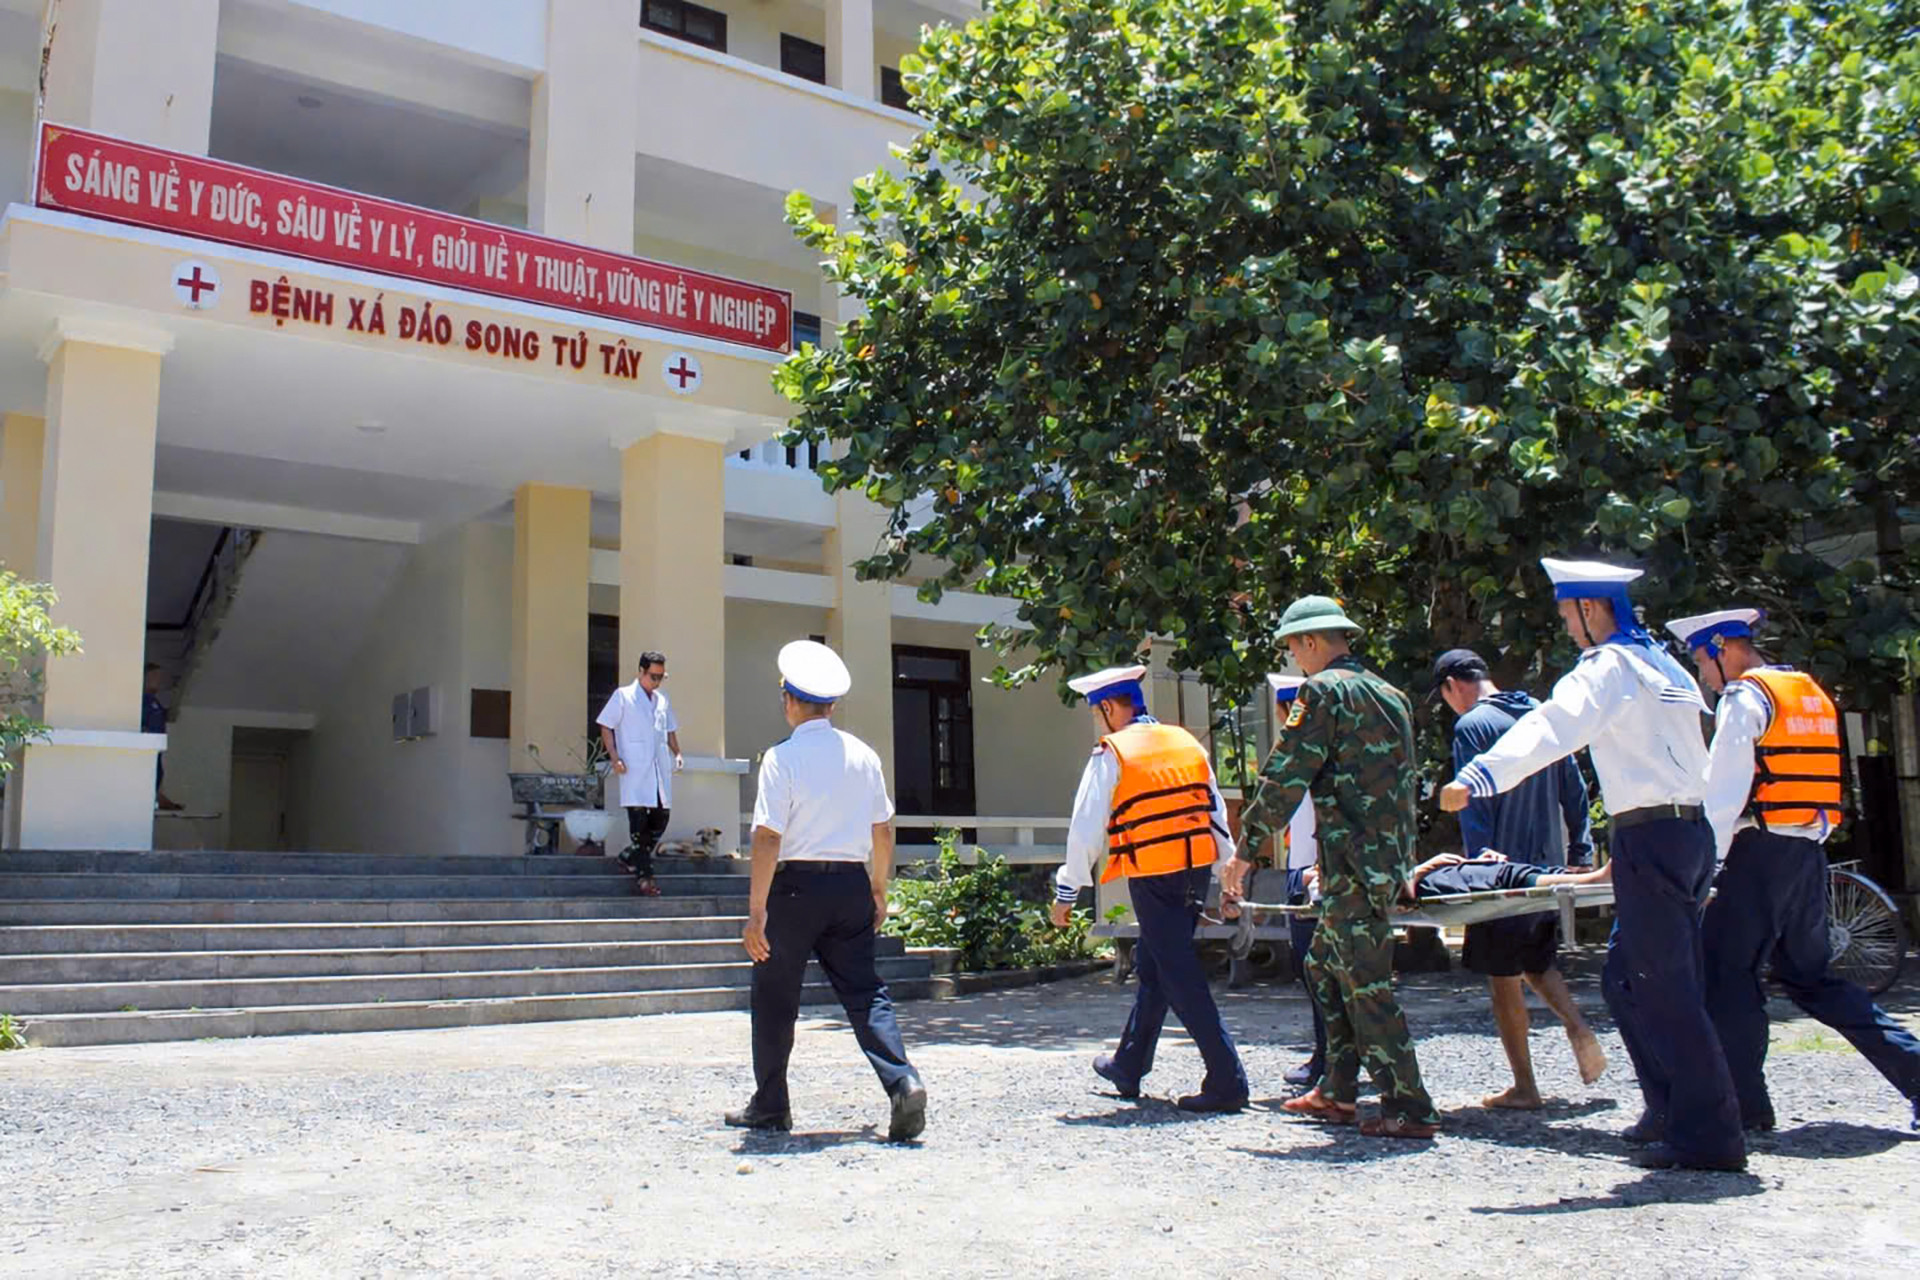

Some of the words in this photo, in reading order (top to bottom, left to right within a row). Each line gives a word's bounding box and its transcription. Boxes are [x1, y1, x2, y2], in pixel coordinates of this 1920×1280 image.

[65, 149, 140, 204] SÁNG
[149, 160, 181, 212] VỀ
[189, 179, 205, 216] Y
[276, 196, 326, 242] SÂU
[333, 201, 363, 250] VỀ
[370, 218, 384, 254] Y
[432, 227, 477, 274] GIỎI
[483, 234, 509, 280] VỀ
[515, 250, 528, 284] Y
[607, 266, 661, 314] VỮNG
[664, 274, 687, 319] VỀ
[693, 289, 705, 321] Y
[709, 292, 777, 340] NGHIỆP
[249, 275, 334, 327] BỆNH
[347, 292, 386, 335] XÁ
[398, 301, 452, 345] ĐẢO
[465, 320, 541, 361] SONG
[552, 330, 588, 369] TỬ
[599, 338, 642, 380] TÂY
